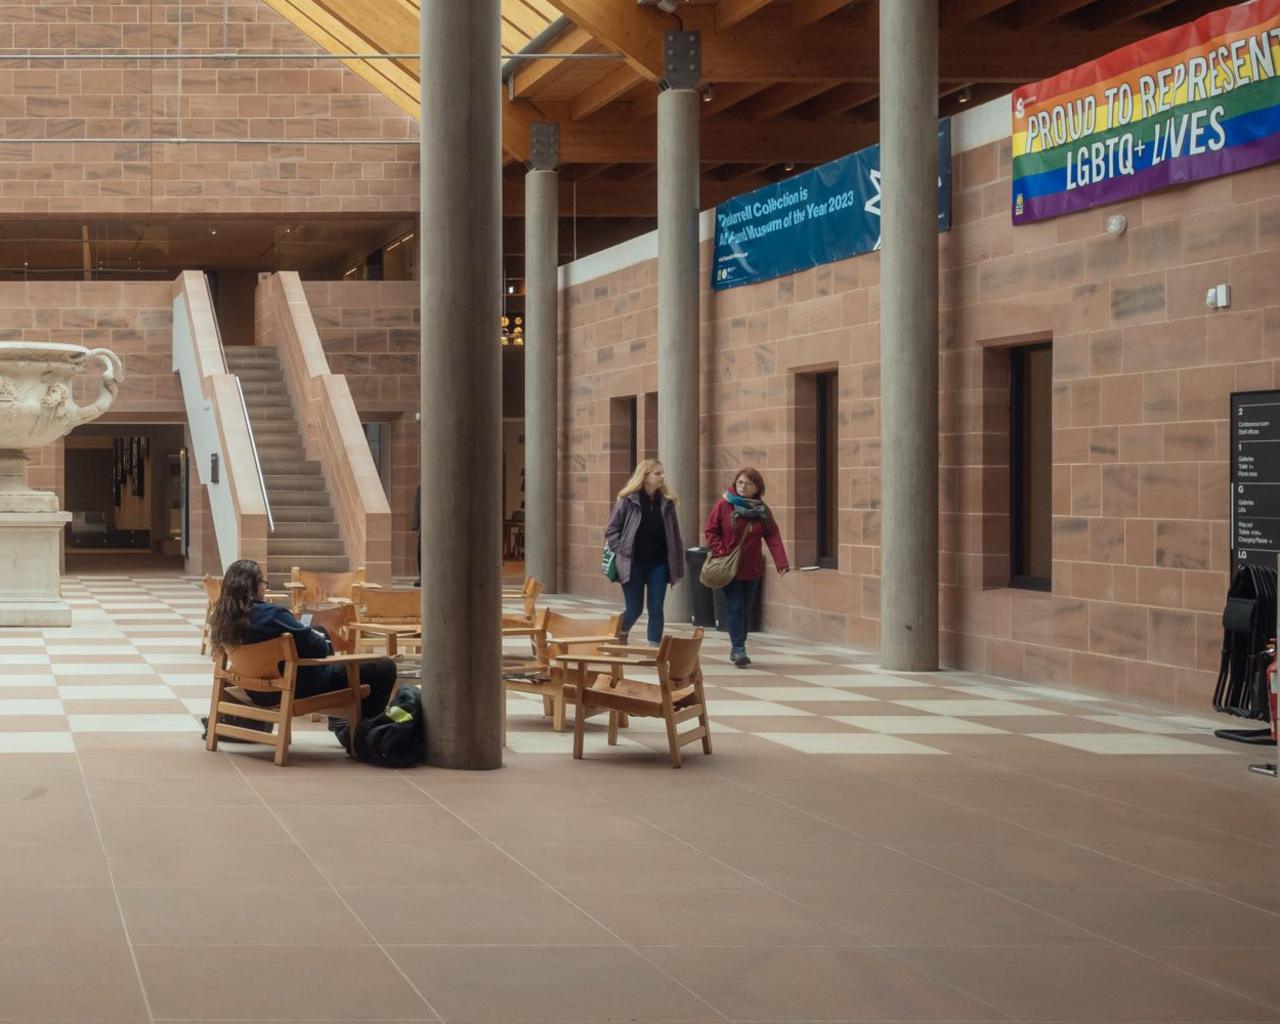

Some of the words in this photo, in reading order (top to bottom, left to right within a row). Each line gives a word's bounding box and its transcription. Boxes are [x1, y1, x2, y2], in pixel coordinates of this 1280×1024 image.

[1025, 95, 1097, 154] PROUD
[1104, 83, 1133, 129] TO
[1065, 132, 1146, 190] LGBTQ+
[1152, 105, 1226, 166] LIVES
[800, 186, 808, 202] is
[783, 210, 792, 228] of
[807, 201, 827, 219] Year
[828, 189, 854, 213] 2023
[1238, 407, 1243, 416] 2
[1238, 443, 1242, 451] 1
[1238, 485, 1244, 494] G
[1238, 550, 1247, 559] LG
